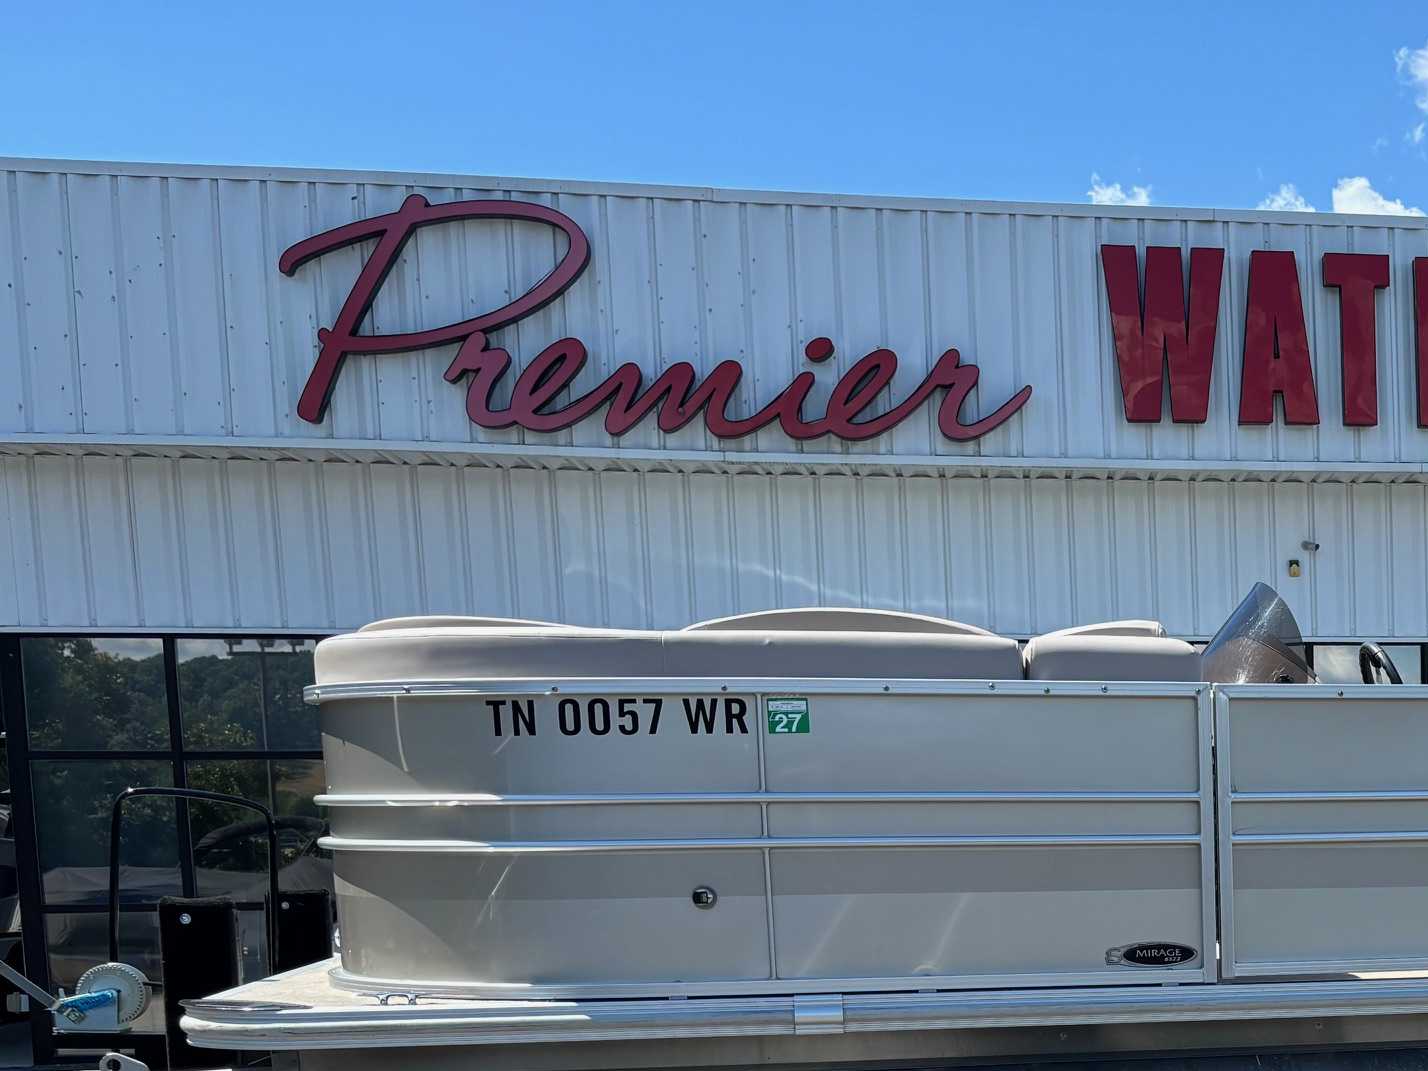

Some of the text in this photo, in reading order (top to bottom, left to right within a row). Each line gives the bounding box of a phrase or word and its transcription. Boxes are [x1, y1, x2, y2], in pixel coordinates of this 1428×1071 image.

[278, 193, 1032, 442] Premier
[486, 697, 749, 736] TN 0057 WR
[774, 713, 802, 733] 27
[1136, 948, 1182, 958] MIRAGE
